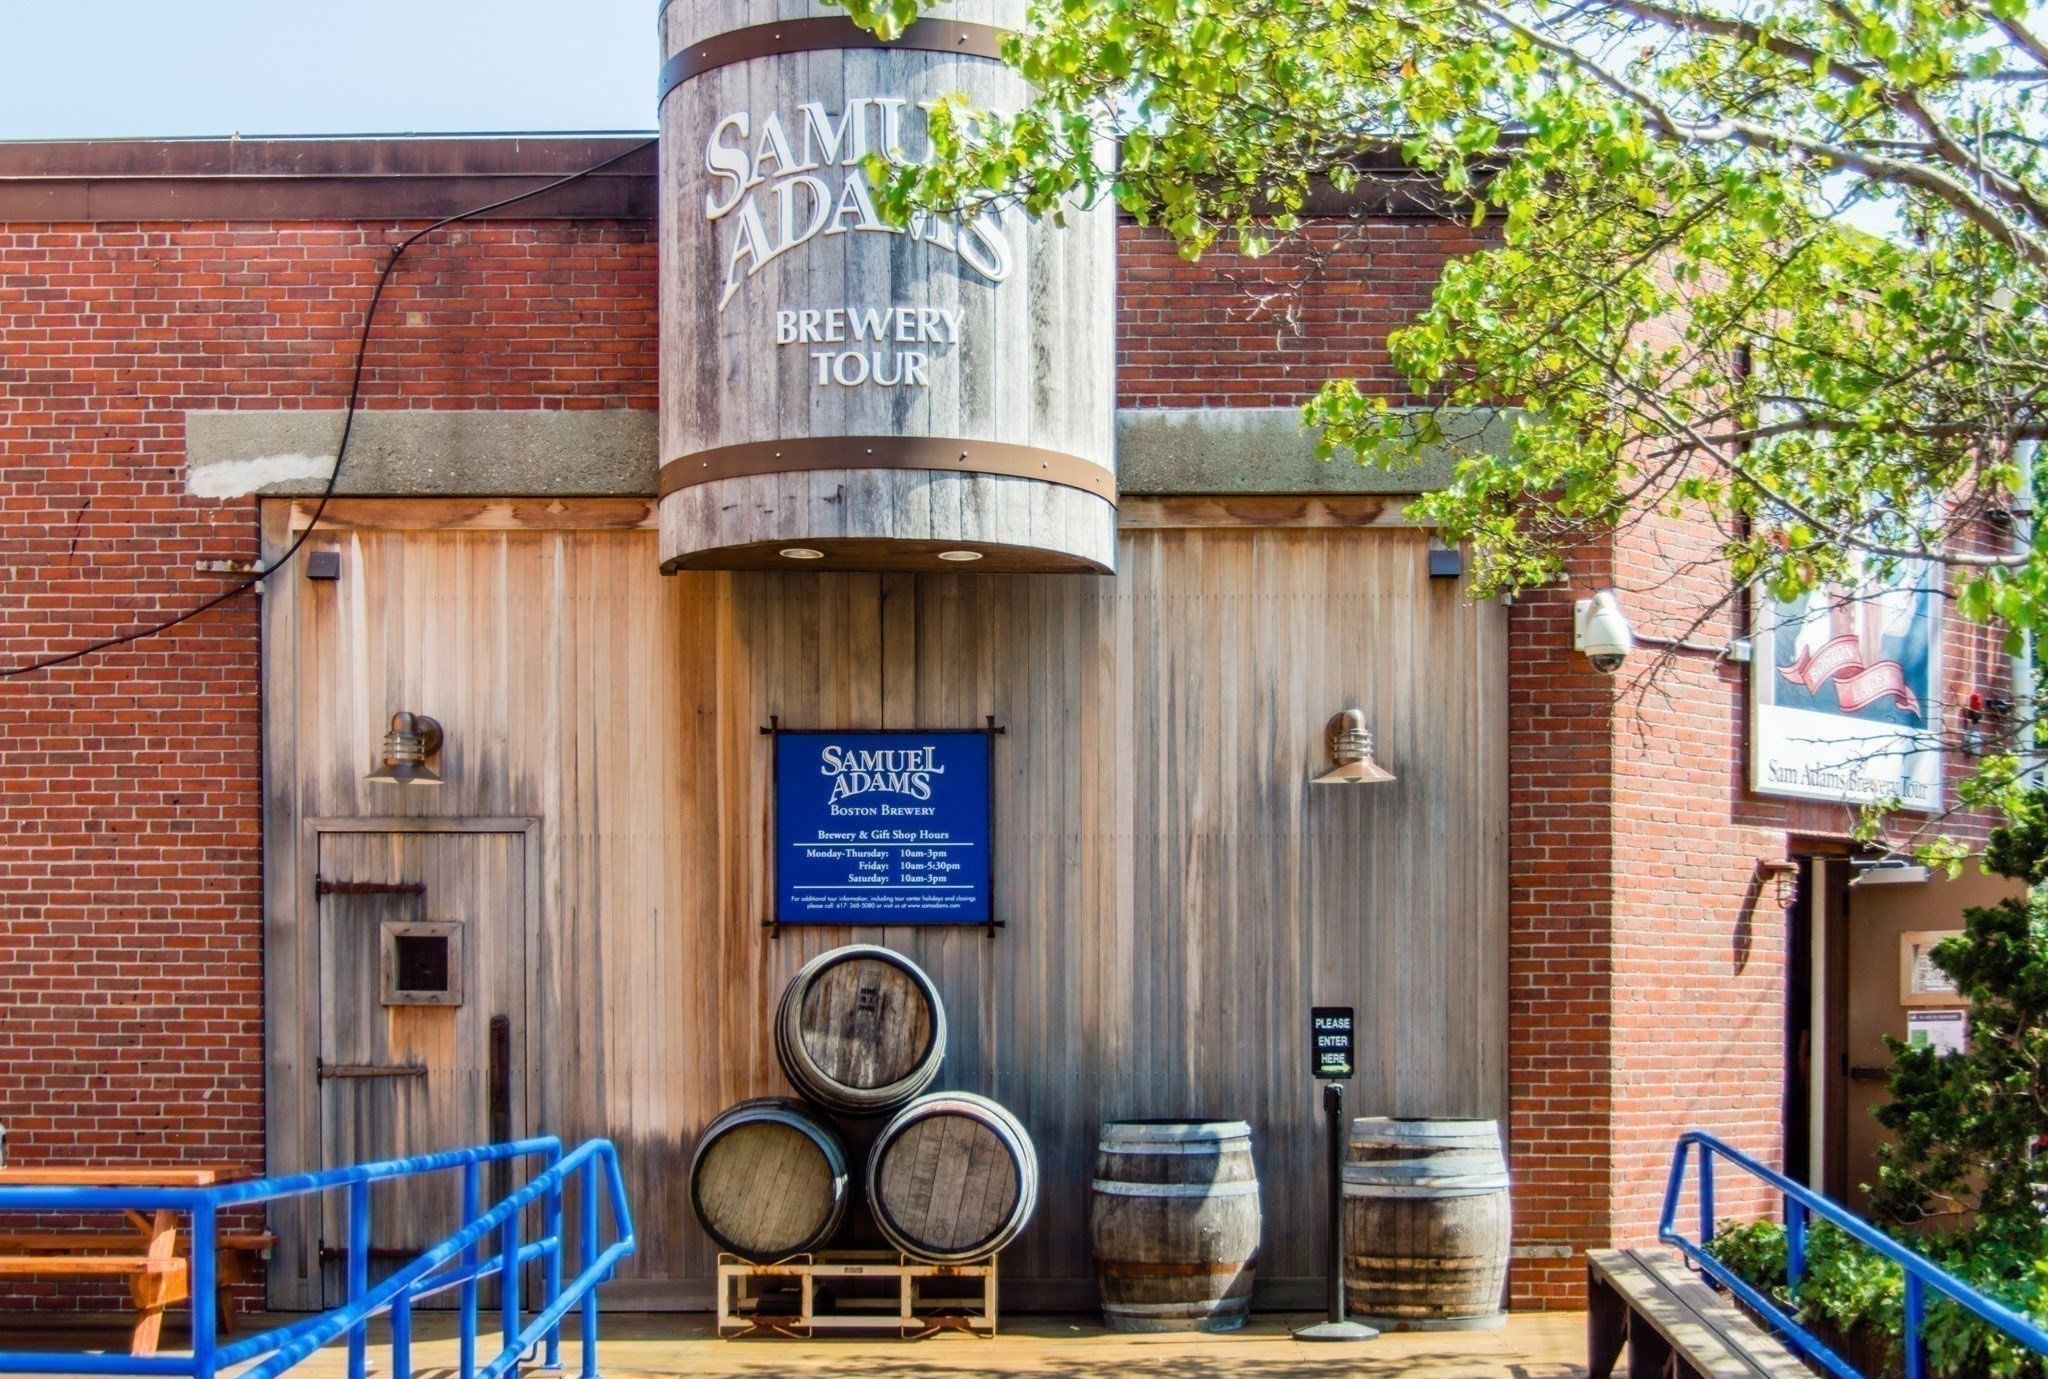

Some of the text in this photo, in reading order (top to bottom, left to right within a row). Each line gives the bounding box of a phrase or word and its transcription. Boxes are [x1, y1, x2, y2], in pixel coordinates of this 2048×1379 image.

[705, 97, 1025, 220] SAMU
[776, 307, 966, 345] BREWERY
[810, 350, 930, 387] TOUR
[821, 745, 945, 776] SAMUEL
[1768, 759, 1798, 785] Sam
[1900, 775, 1929, 800] Tour
[827, 771, 931, 805] ADAMS
[818, 829, 949, 842] Brewery & Gift Shop Hours
[806, 848, 947, 860] Monday-Thursday: 10am-3pm
[858, 861, 961, 872] Friday: 10am-5:30pm
[848, 873, 947, 885] Saturday: 10am-3pm
[871, 894, 893, 903] including
[922, 894, 943, 903] holidays
[955, 895, 976, 903] closings
[807, 902, 824, 910] please
[1315, 1018, 1350, 1029] PLEASE
[1318, 1036, 1348, 1046] ENTER
[1321, 1053, 1345, 1063] HERE
